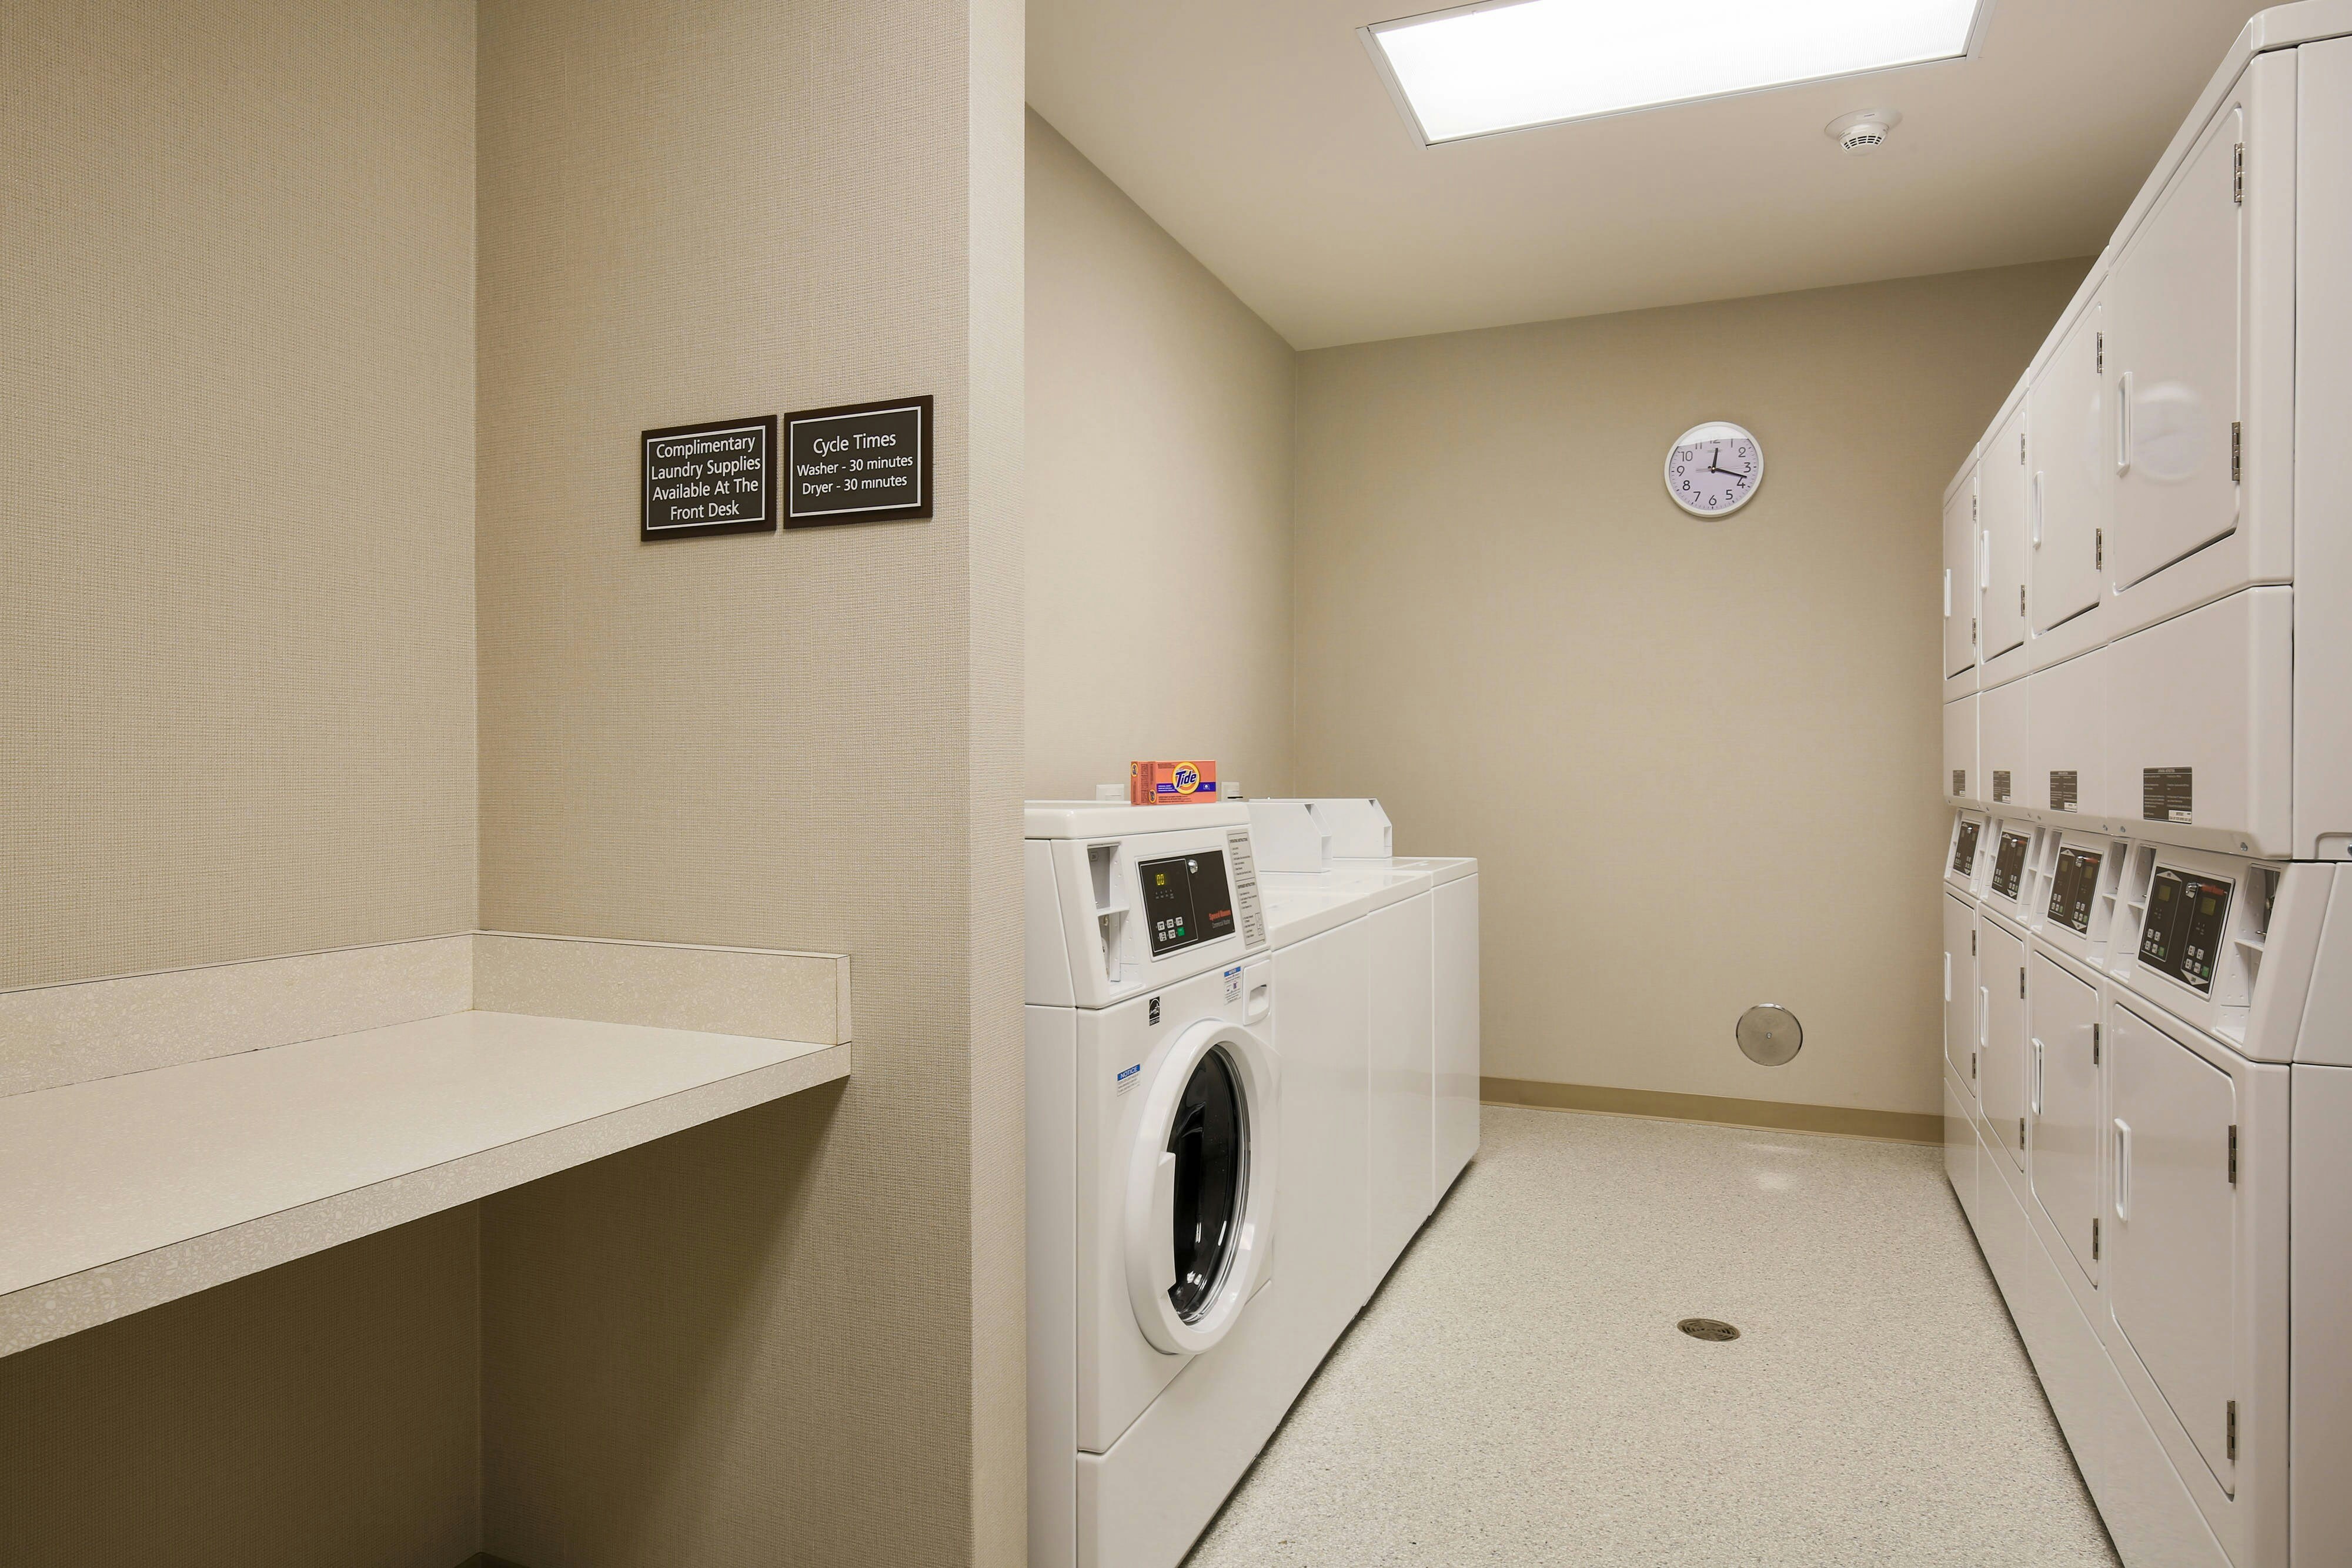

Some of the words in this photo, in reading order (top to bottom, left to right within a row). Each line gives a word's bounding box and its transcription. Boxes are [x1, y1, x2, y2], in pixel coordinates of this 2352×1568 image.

[656, 437, 756, 459] Complimentary
[813, 436, 849, 457] Cycle
[853, 433, 896, 449] Times
[1681, 450, 1693, 462] 10
[1738, 447, 1746, 457] 2
[652, 462, 703, 480] Laundry
[707, 456, 761, 476] Supplies
[797, 462, 838, 476] Washer
[850, 459, 863, 472] 30
[867, 456, 913, 470] minutes
[1676, 466, 1685, 477] 9
[1743, 462, 1751, 473] 3
[652, 482, 710, 501] Available
[714, 480, 730, 495] At
[733, 477, 759, 493] The
[803, 483, 833, 497] Dryer
[844, 478, 858, 491] 30
[861, 476, 907, 489] minutes
[1682, 480, 1690, 491] 8
[1736, 476, 1745, 489] 4
[1693, 491, 1700, 502] 7
[1709, 495, 1717, 506] 6
[1726, 490, 1733, 500] 5
[670, 504, 704, 520] Front
[709, 500, 740, 517] Desk
[1175, 770, 1197, 788] Tide
[1120, 1066, 1138, 1079] NOTICE
